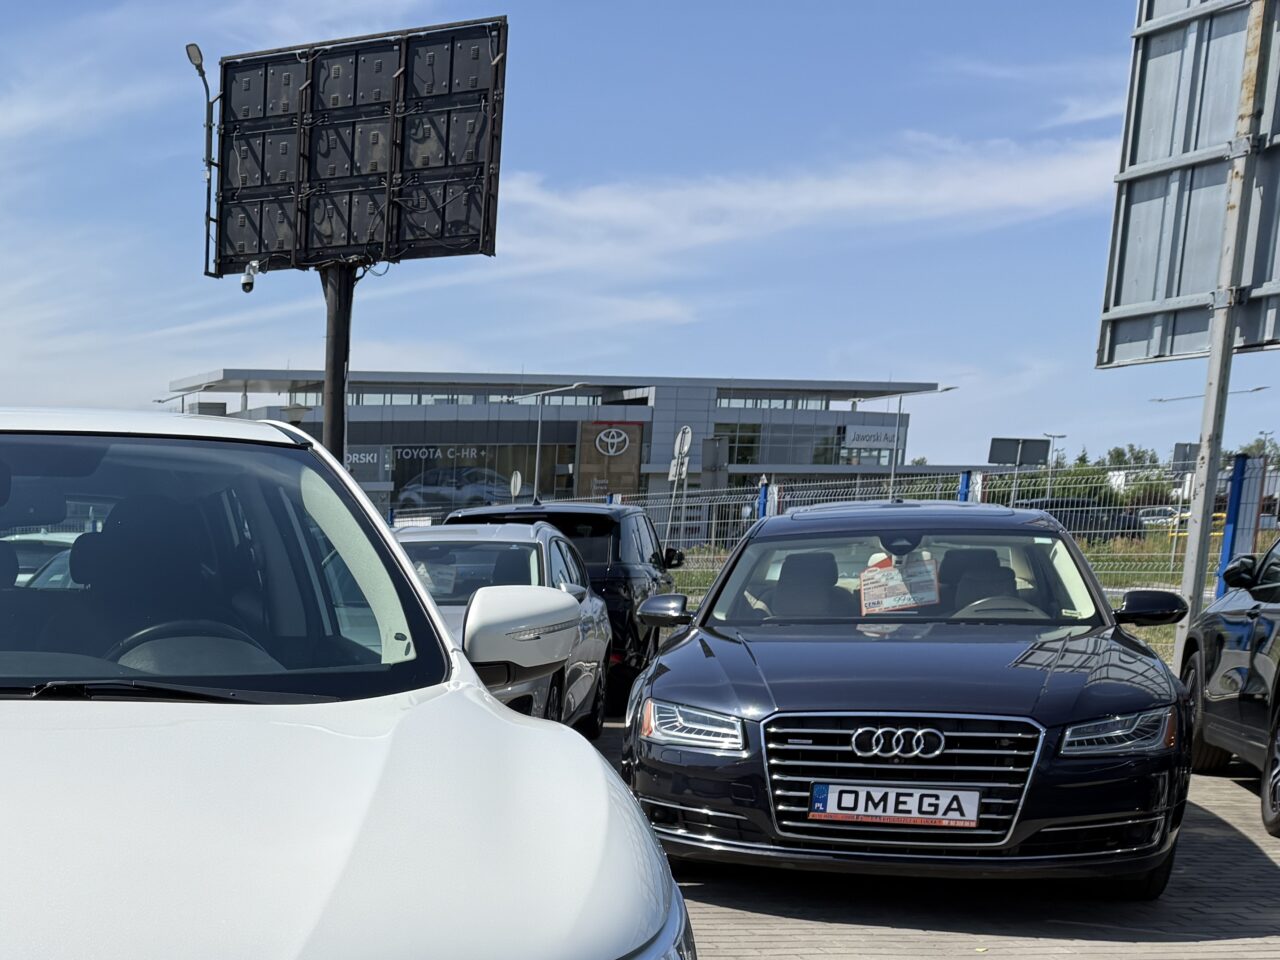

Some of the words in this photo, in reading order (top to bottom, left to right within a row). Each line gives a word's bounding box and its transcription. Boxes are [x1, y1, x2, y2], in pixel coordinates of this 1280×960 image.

[395, 448, 443, 459] TOYOTA
[447, 447, 477, 459] C-HR
[836, 790, 966, 817] OMEGA
